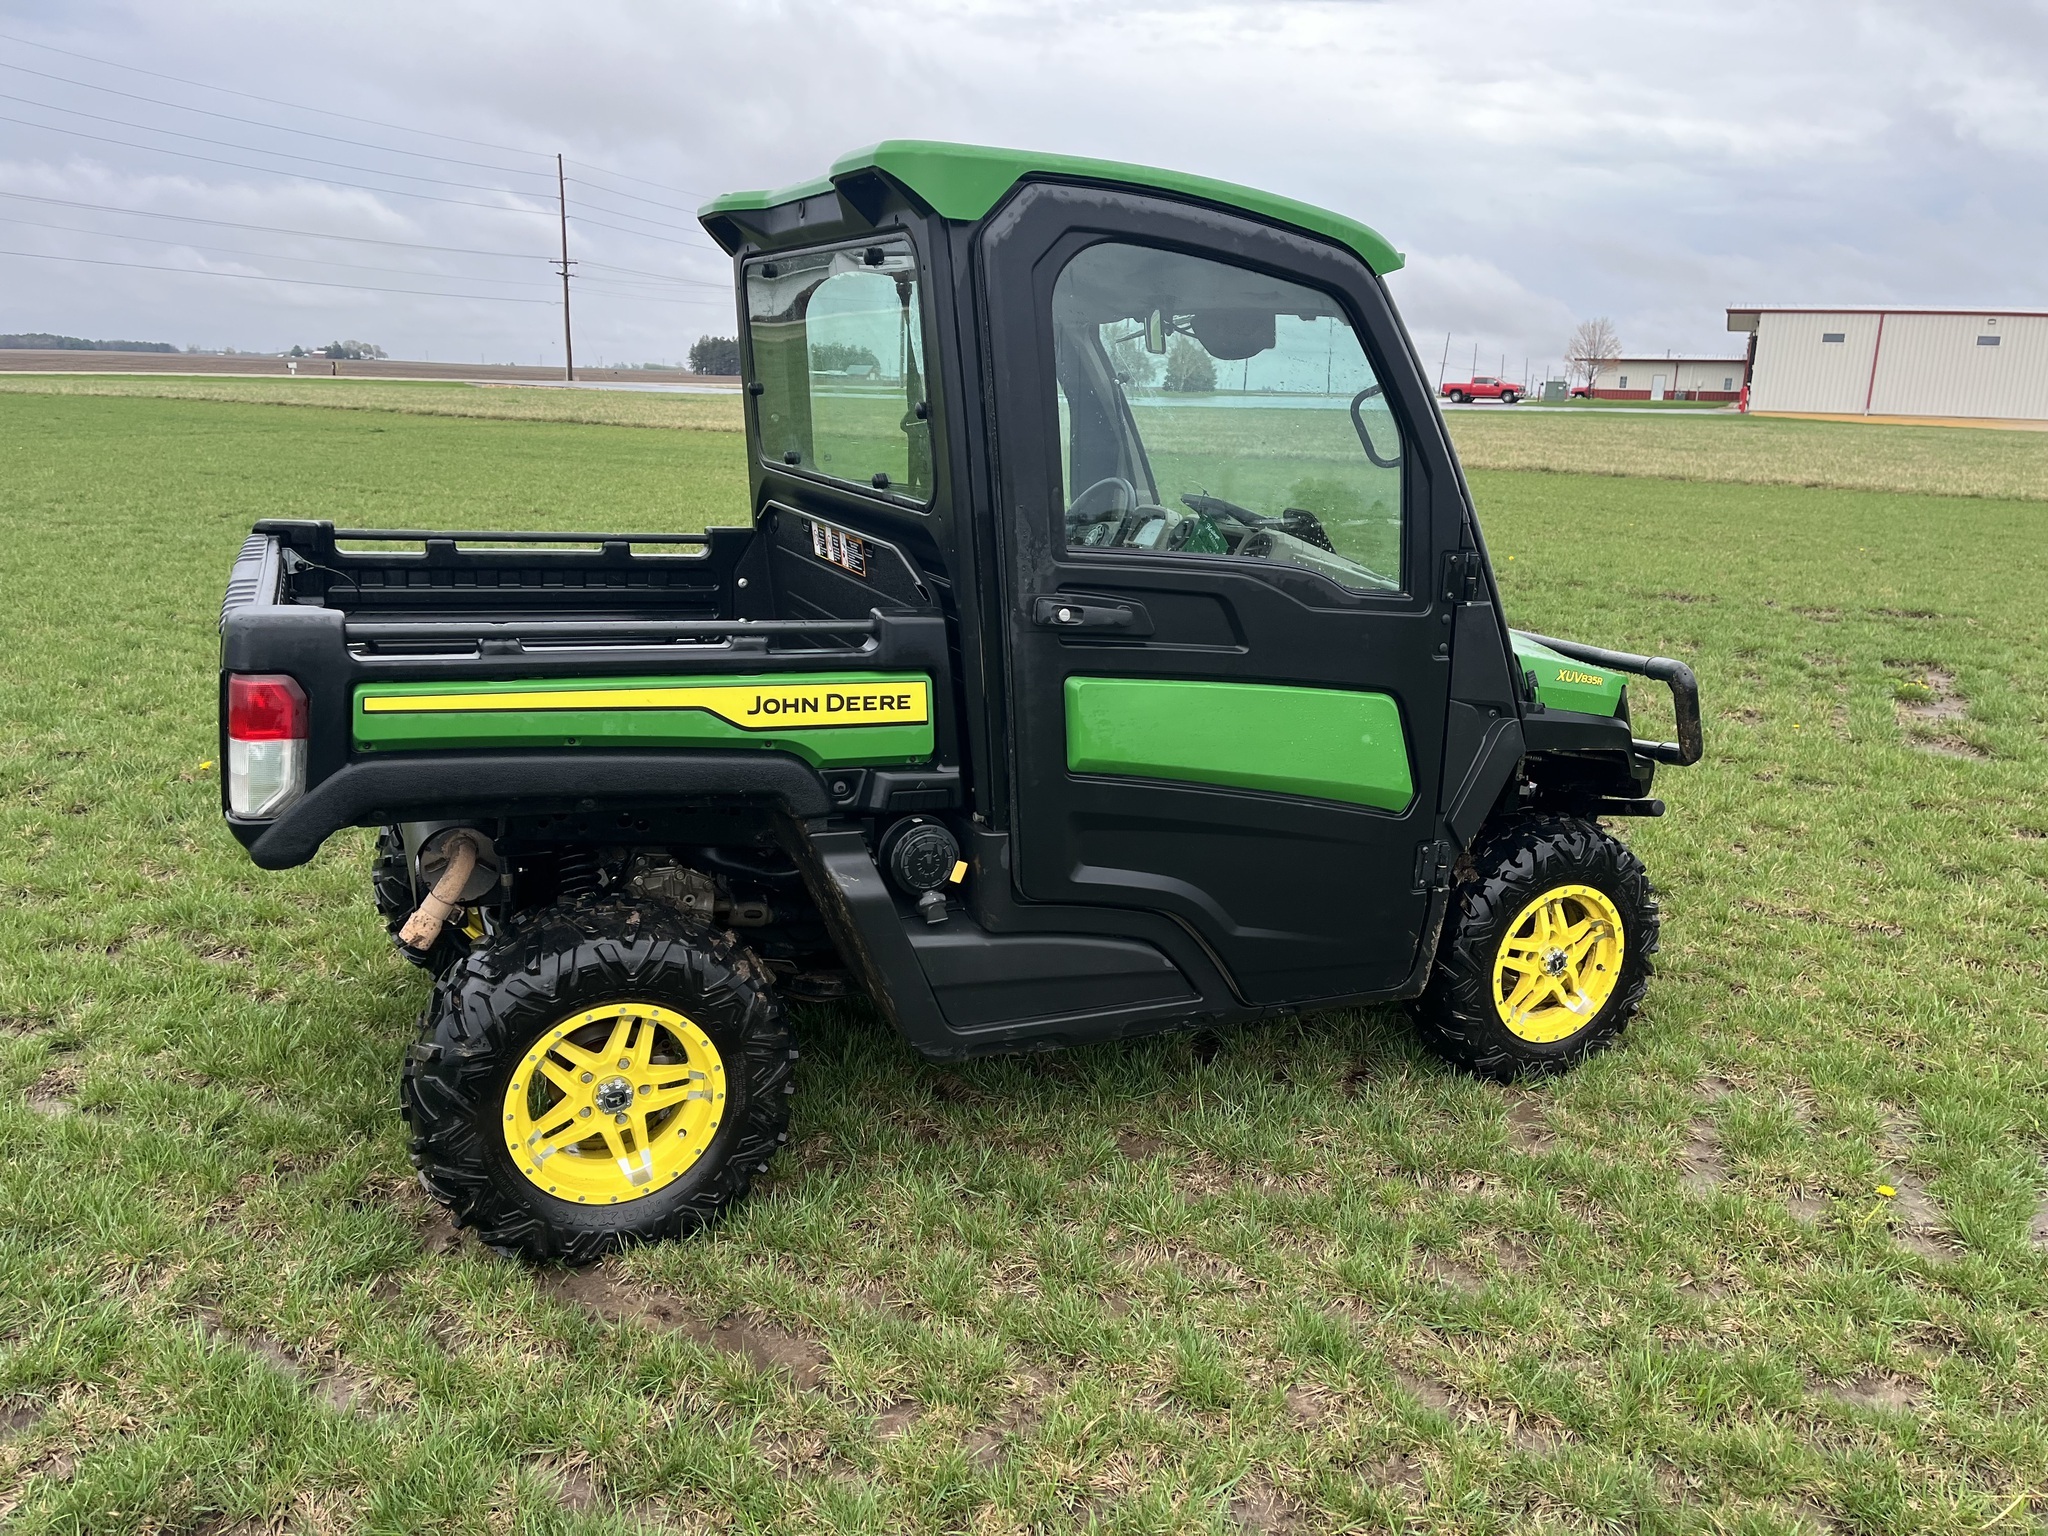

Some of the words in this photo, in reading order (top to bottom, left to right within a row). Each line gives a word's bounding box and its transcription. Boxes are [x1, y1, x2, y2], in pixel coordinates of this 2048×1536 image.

[1555, 668, 1604, 687] XUV835R
[747, 695, 819, 715] JOHN
[826, 693, 911, 712] DEERE
